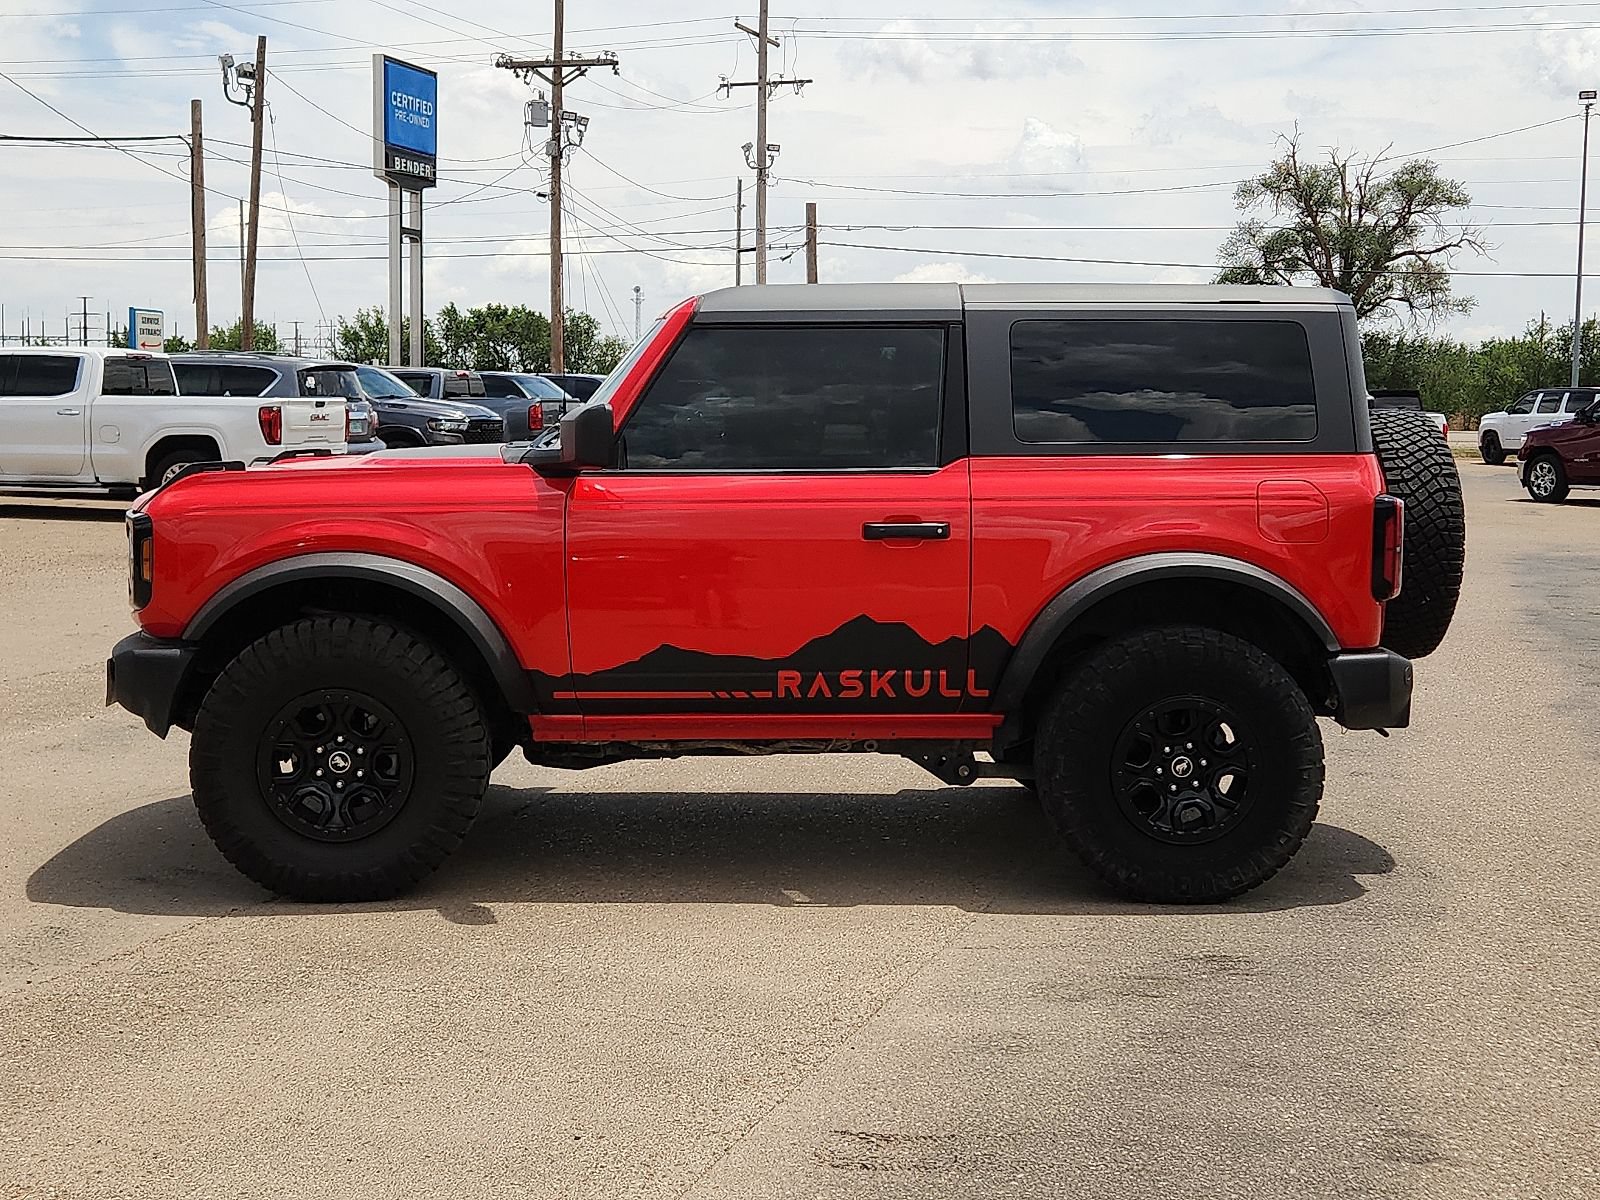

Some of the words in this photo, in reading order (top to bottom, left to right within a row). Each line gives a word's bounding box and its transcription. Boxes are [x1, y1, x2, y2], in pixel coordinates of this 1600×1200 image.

[391, 91, 433, 116] CERTIFIED
[395, 108, 430, 128] PRE-OWNED
[394, 157, 432, 177] BENDER
[310, 413, 330, 421] GMC
[777, 669, 989, 698] RASKULL
